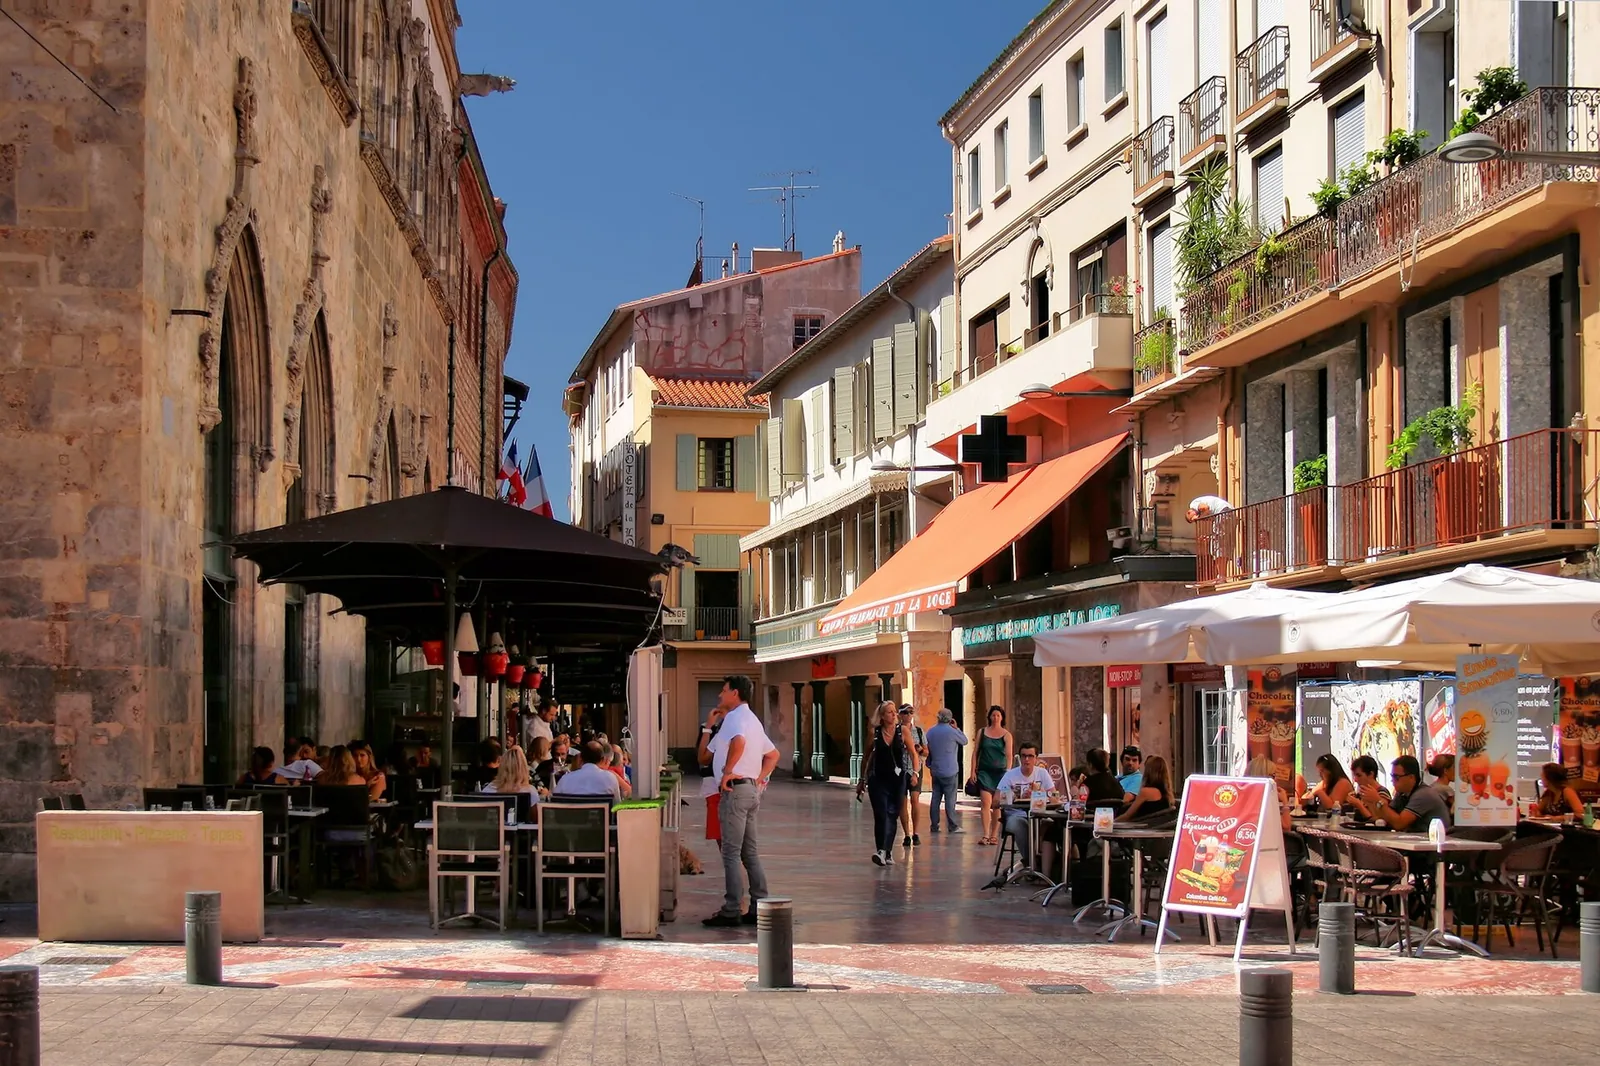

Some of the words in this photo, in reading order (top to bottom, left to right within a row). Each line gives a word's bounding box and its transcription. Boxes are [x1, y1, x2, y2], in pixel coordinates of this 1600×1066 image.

[625, 444, 635, 496] HOTEL
[846, 605, 890, 626] PHARMACIE
[893, 601, 906, 615] DE
[907, 598, 921, 611] LA
[926, 590, 952, 609] LOGE
[961, 624, 995, 646] GRANDE
[995, 614, 1051, 642] PHARMACIE
[1052, 611, 1068, 630] DE
[1068, 609, 1086, 626] LA
[1087, 603, 1121, 623] LOGE
[1463, 657, 1497, 677] Envie
[1109, 669, 1133, 682] NON-STOP
[1248, 691, 1294, 701] Chocolats
[1306, 717, 1328, 726] BESTIAL
[1184, 813, 1221, 823] Formules
[52, 825, 122, 841] Restaurant
[134, 825, 189, 842] Pizzeria
[201, 825, 244, 844] Tapas
[1181, 822, 1217, 835] déjeuner
